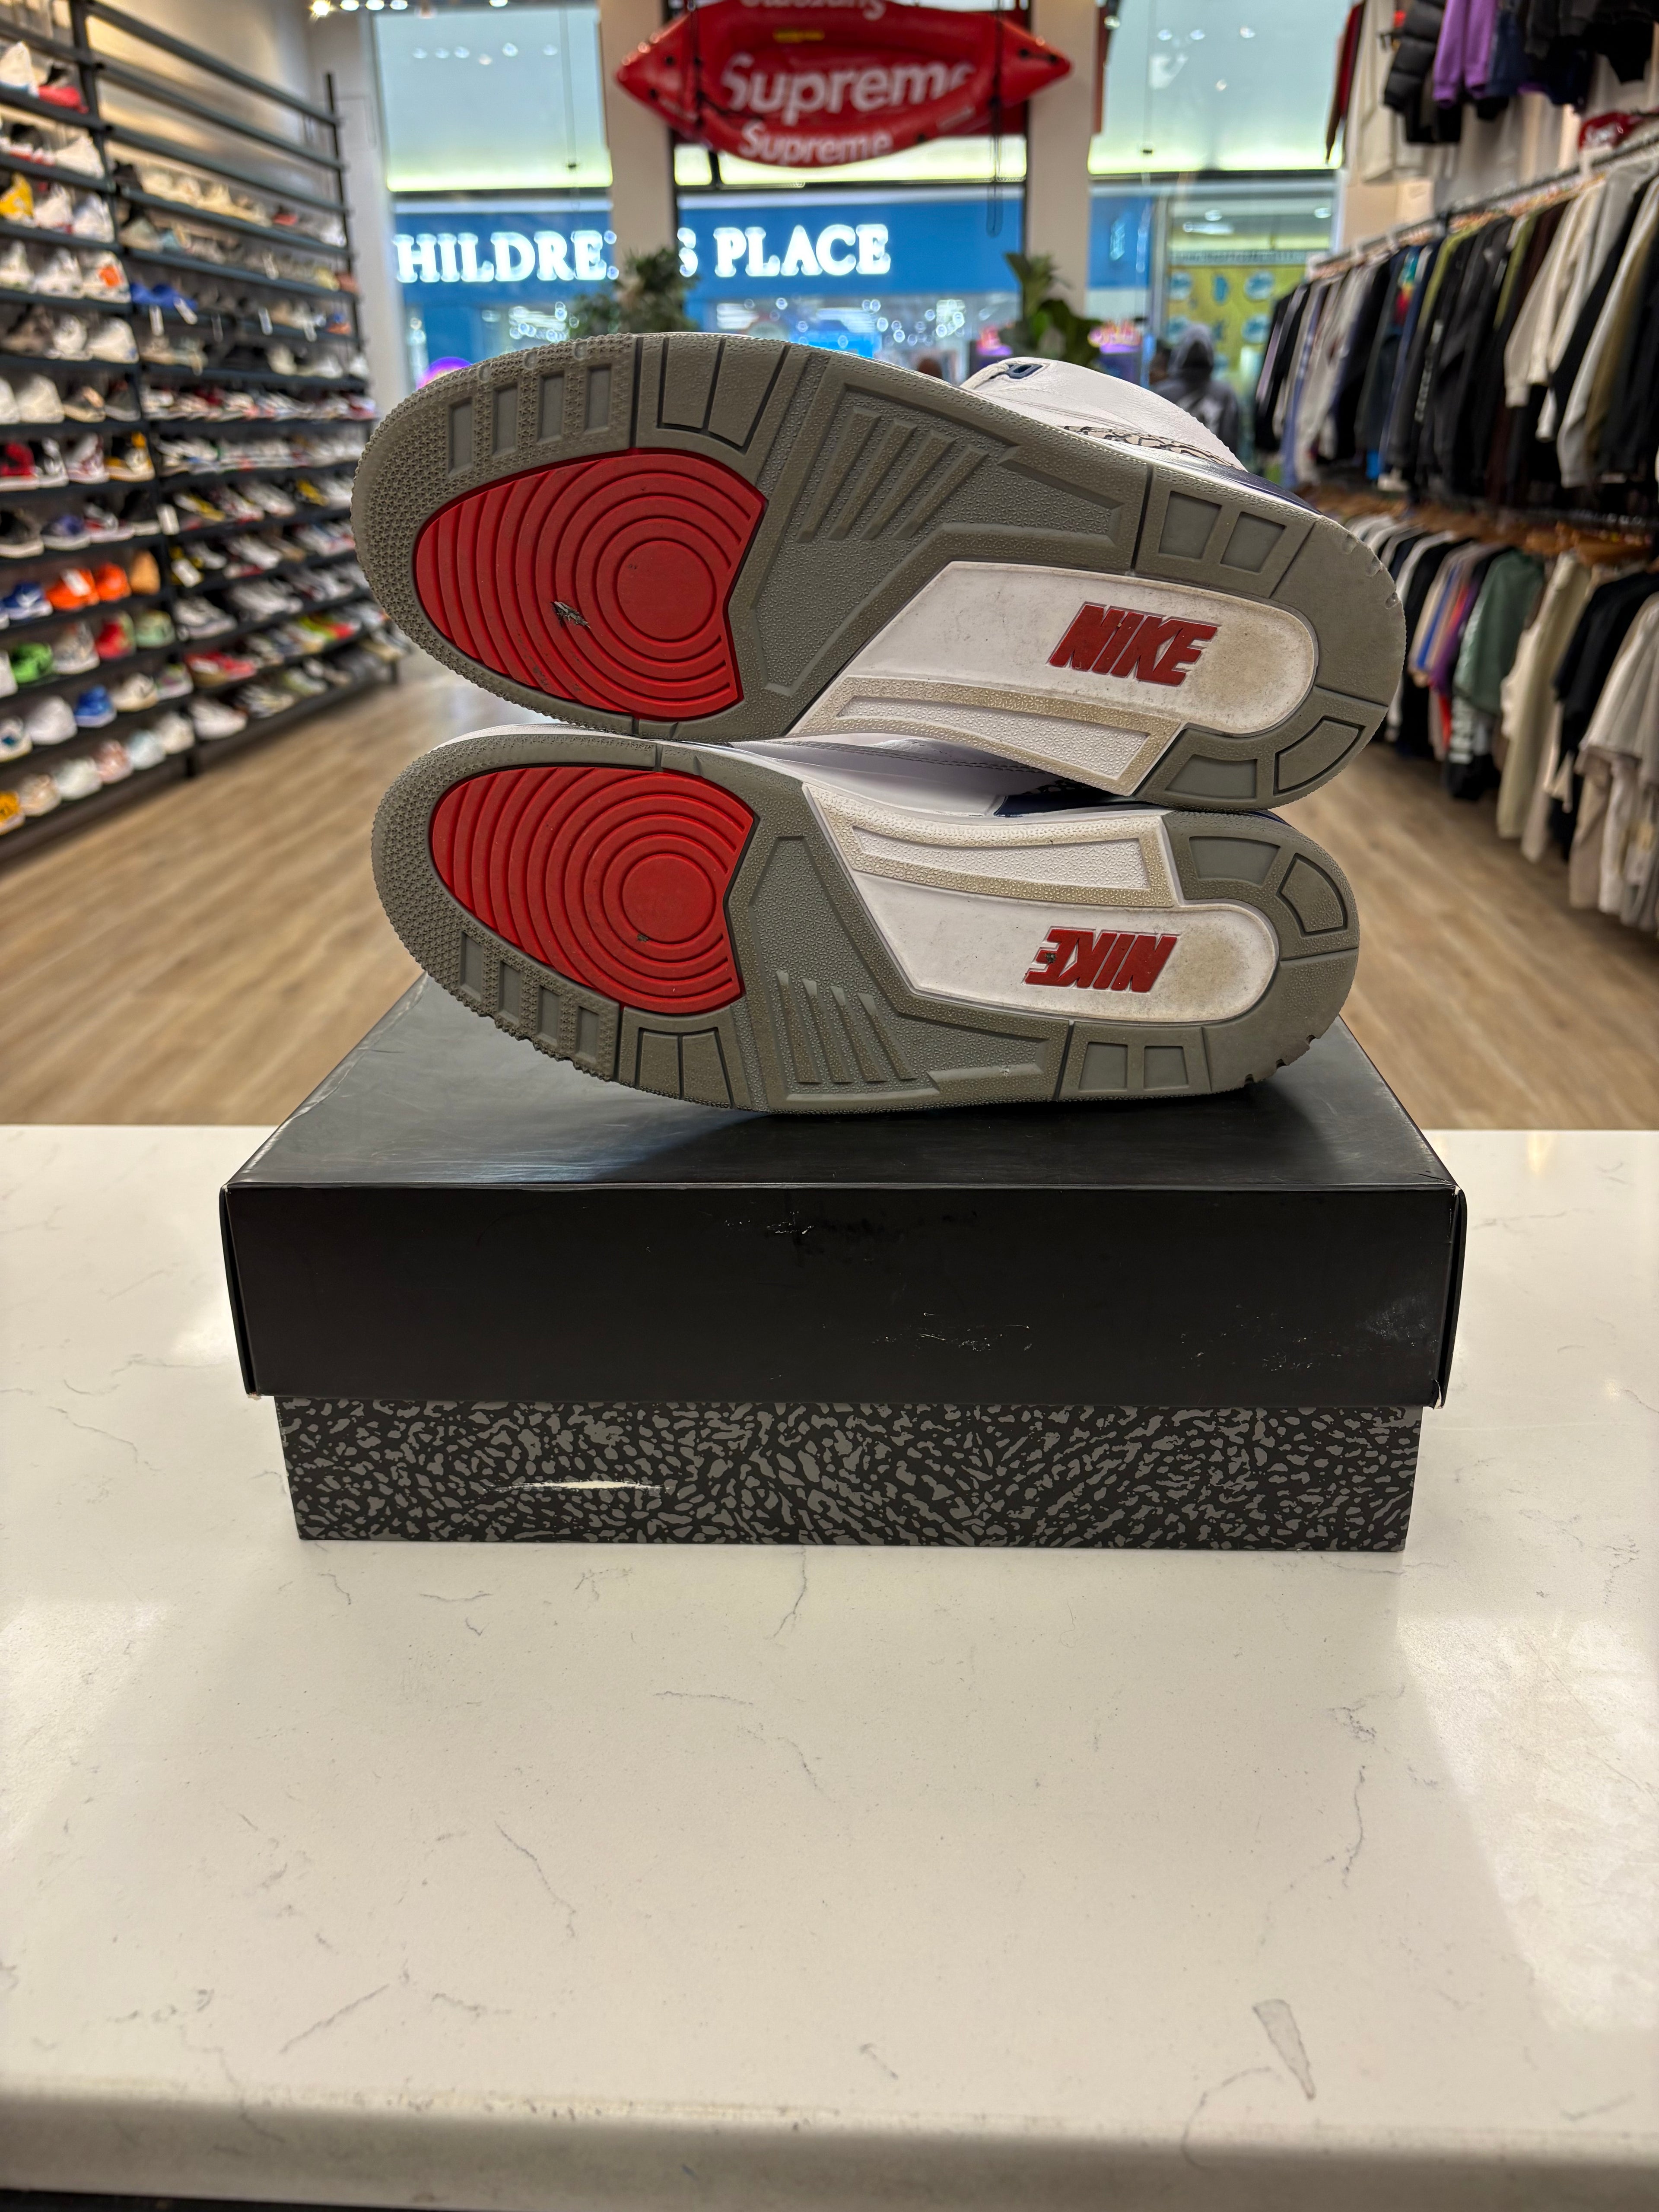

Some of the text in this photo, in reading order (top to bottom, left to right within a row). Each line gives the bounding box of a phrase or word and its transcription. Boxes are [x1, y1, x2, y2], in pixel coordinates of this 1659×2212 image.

[738, 120, 893, 165] Supreme
[713, 224, 891, 277] PLACE
[1046, 602, 1219, 687] NIKE
[1022, 927, 1179, 994] NIKE
